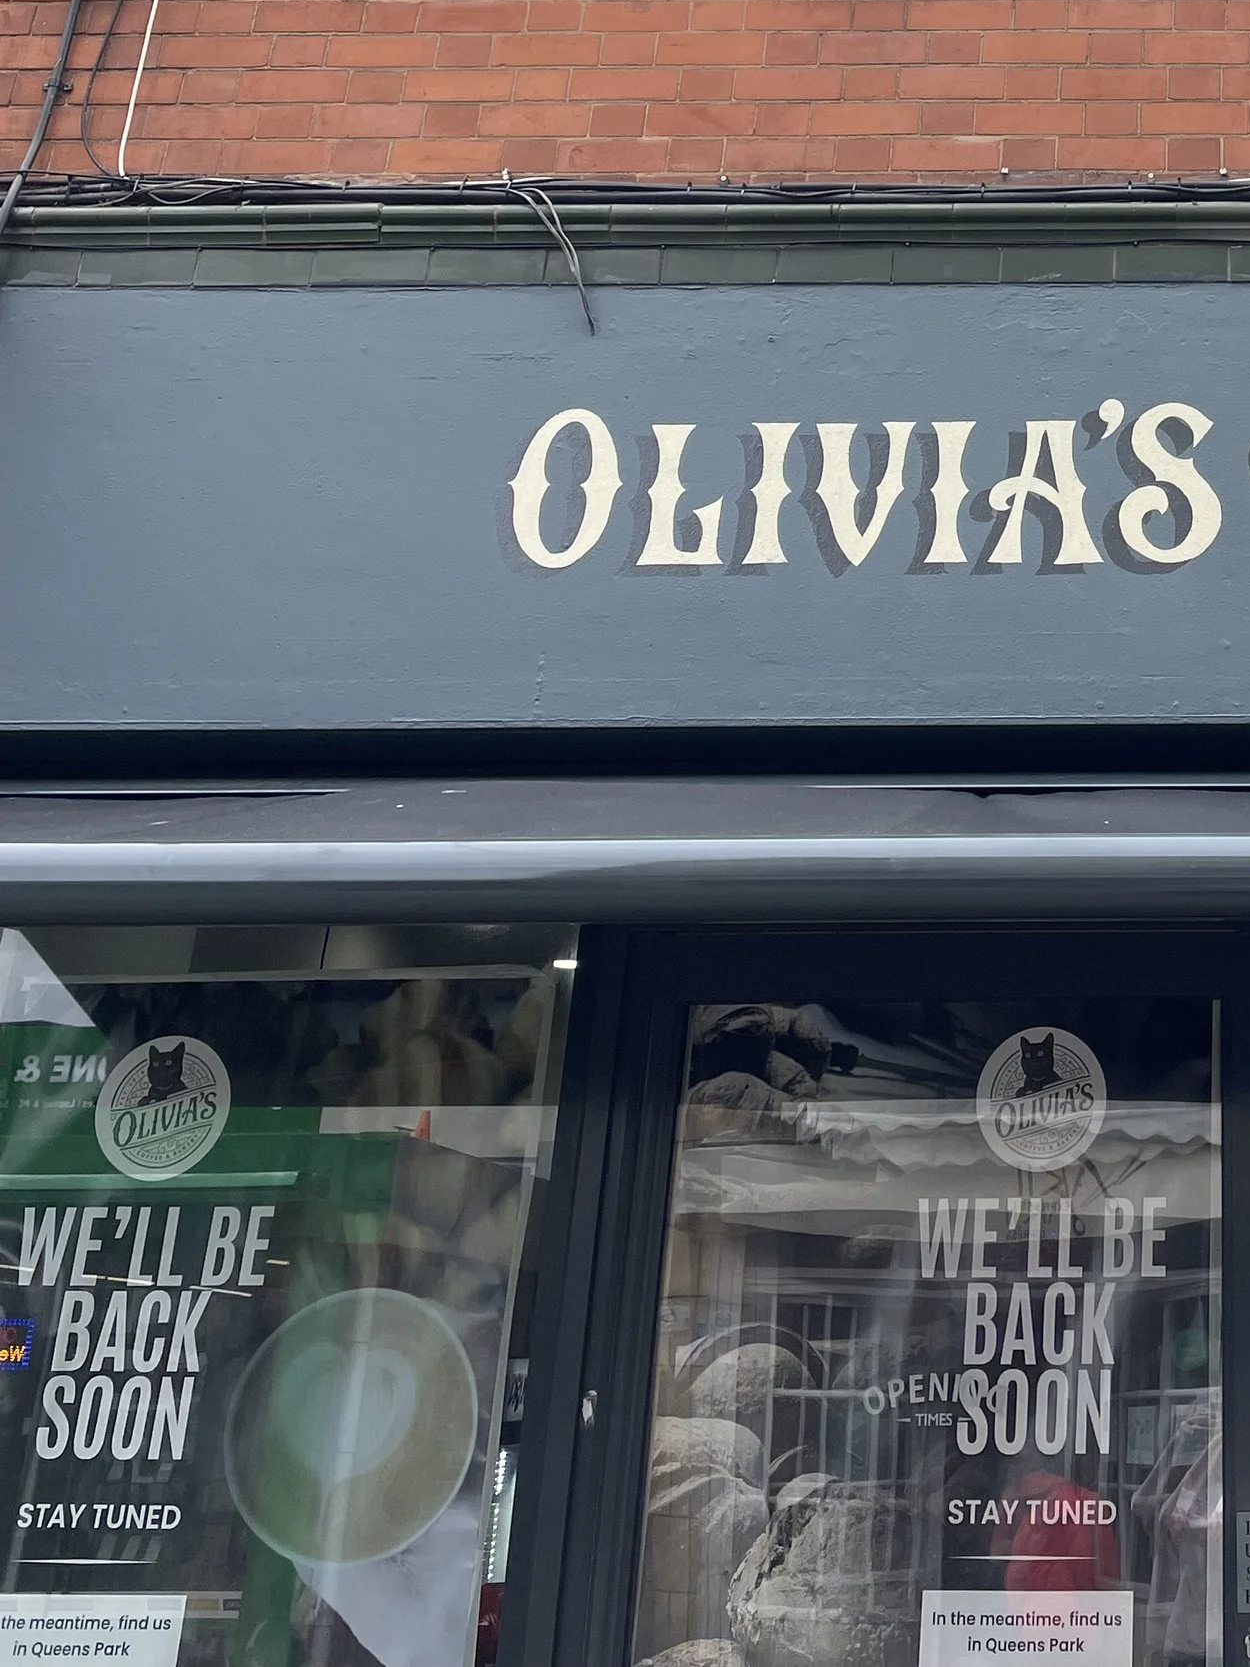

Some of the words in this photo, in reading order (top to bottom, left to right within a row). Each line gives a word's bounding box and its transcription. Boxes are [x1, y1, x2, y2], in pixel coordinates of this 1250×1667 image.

[510, 398, 1222, 571] OLIVIA'S
[113, 1092, 217, 1148] OLIVIA'S
[995, 1083, 1094, 1138] OLIVIA'S
[18, 1206, 183, 1287] WE'LL
[201, 1205, 275, 1287] BE
[918, 1197, 1083, 1279] WE'LL
[1103, 1196, 1167, 1279] BE
[51, 1289, 212, 1373] BACK
[963, 1282, 1116, 1367] BACK
[35, 1376, 195, 1461] SOON
[915, 1413, 953, 1426] TIMES
[955, 1368, 1111, 1456] SOON
[17, 1503, 87, 1530] STAY
[91, 1503, 182, 1530] TUNED
[947, 1499, 1019, 1526] STAY
[1026, 1499, 1117, 1526] TUNED
[1, 1615, 25, 1630] the
[29, 1614, 114, 1632] meantime,
[118, 1615, 149, 1630] find
[153, 1619, 171, 1630] us
[932, 1612, 946, 1626] In
[951, 1611, 976, 1626] the
[980, 1611, 1065, 1628] meantime,
[1069, 1611, 1099, 1626] find
[1103, 1615, 1122, 1626] us
[968, 1637, 981, 1651] in
[986, 1638, 1045, 1654] Queens
[1050, 1637, 1084, 1652] Park
[13, 1641, 27, 1656] in
[31, 1641, 90, 1658] Queens
[94, 1641, 130, 1656] Park
